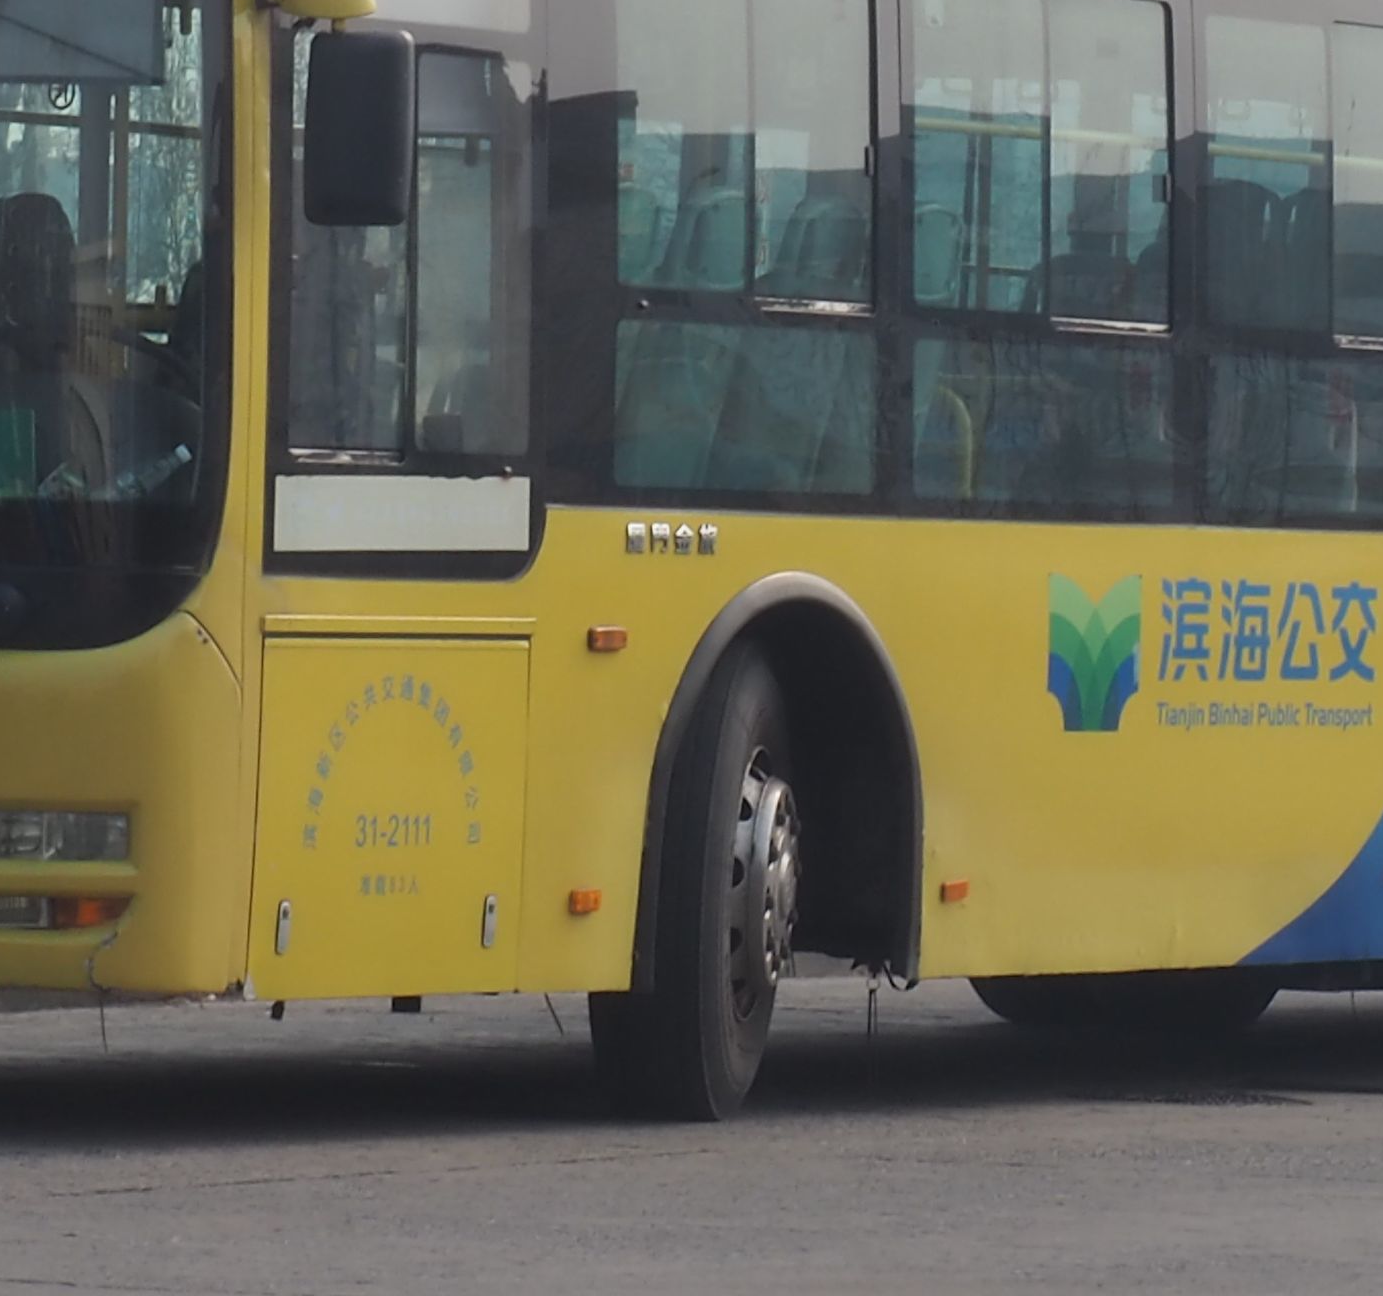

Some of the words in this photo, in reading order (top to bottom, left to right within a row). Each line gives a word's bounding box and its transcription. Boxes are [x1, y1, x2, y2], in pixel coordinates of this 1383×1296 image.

[1158, 577, 1378, 682] 滨海公交
[1156, 702, 1205, 731] Tianjin
[1209, 702, 1254, 726] Binhai
[1258, 702, 1300, 726] Public
[1305, 702, 1373, 731] Transport
[355, 814, 432, 848] 31-2111
